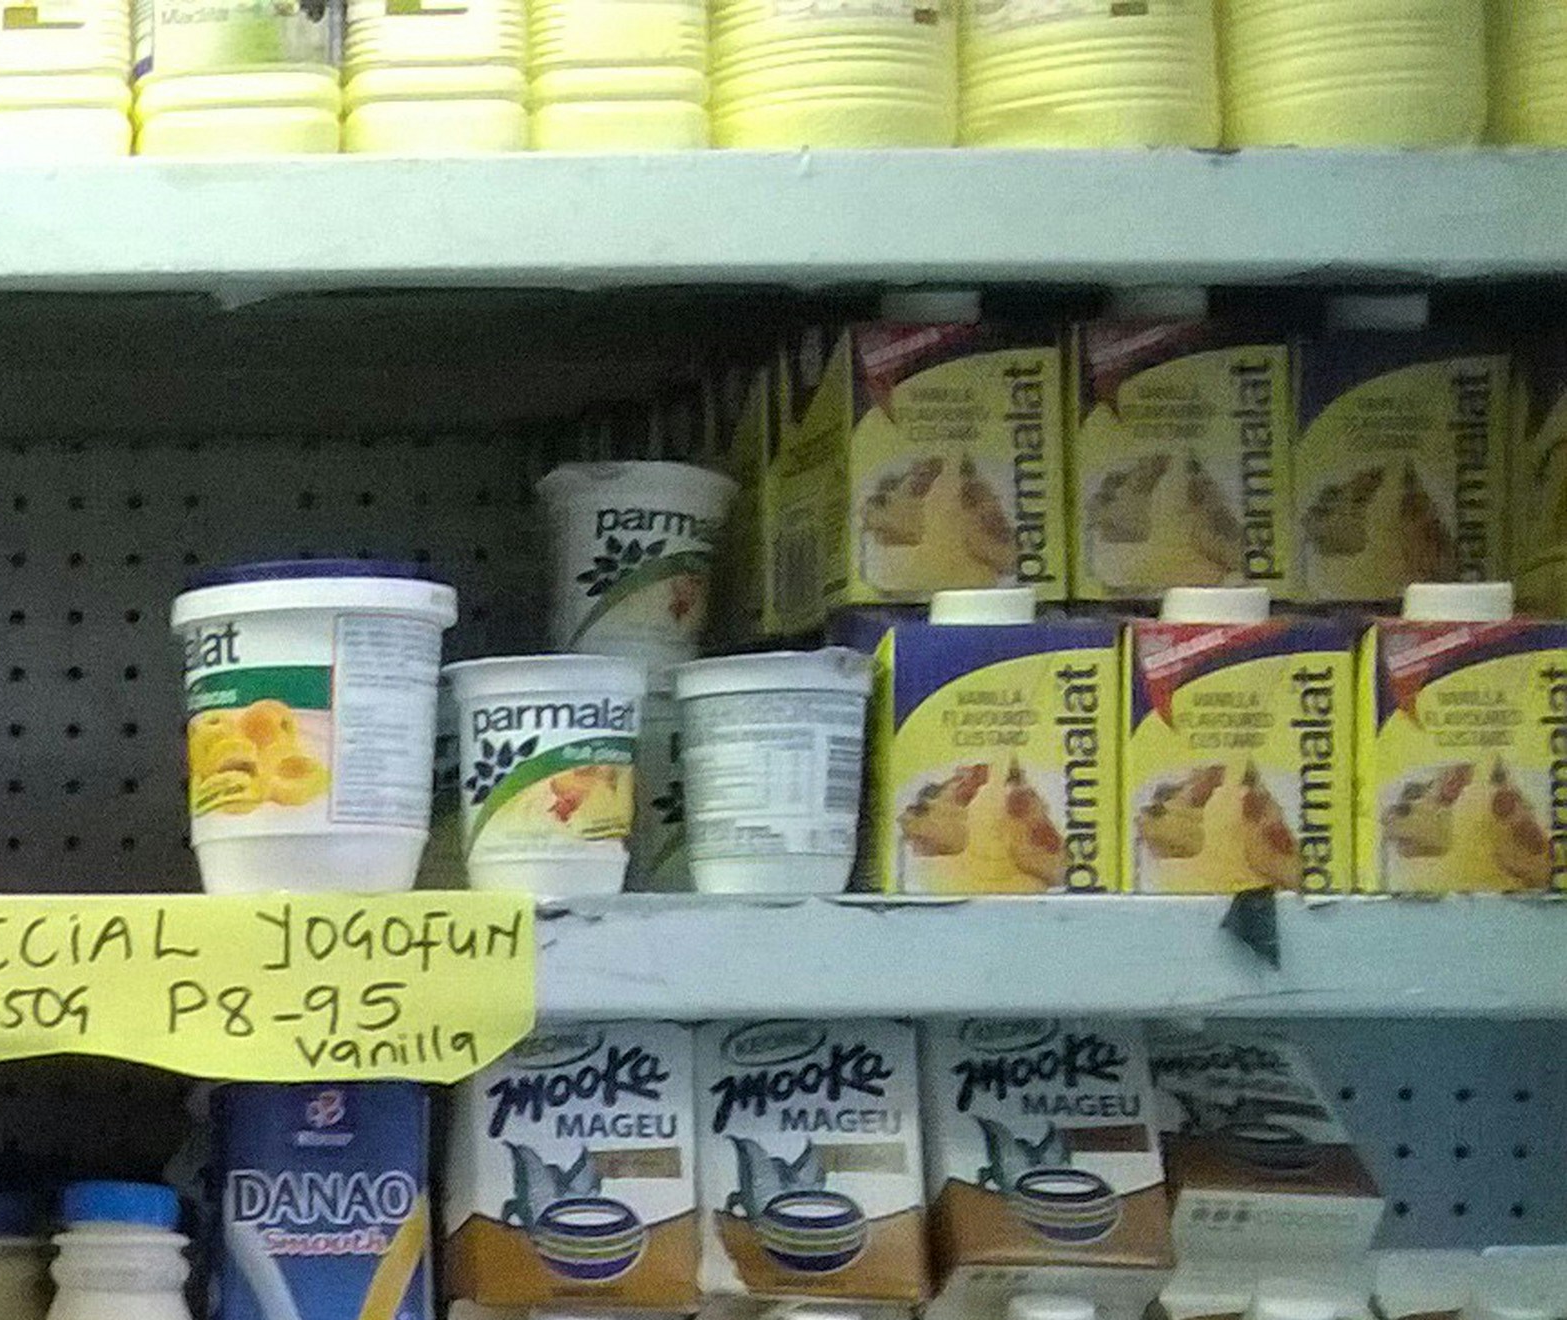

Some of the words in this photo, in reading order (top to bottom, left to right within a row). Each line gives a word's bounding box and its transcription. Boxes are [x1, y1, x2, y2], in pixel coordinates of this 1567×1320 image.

[556, 1113, 677, 1139] MAGEU
[780, 1107, 903, 1134] MAGEU
[229, 1169, 418, 1225] DANAO
